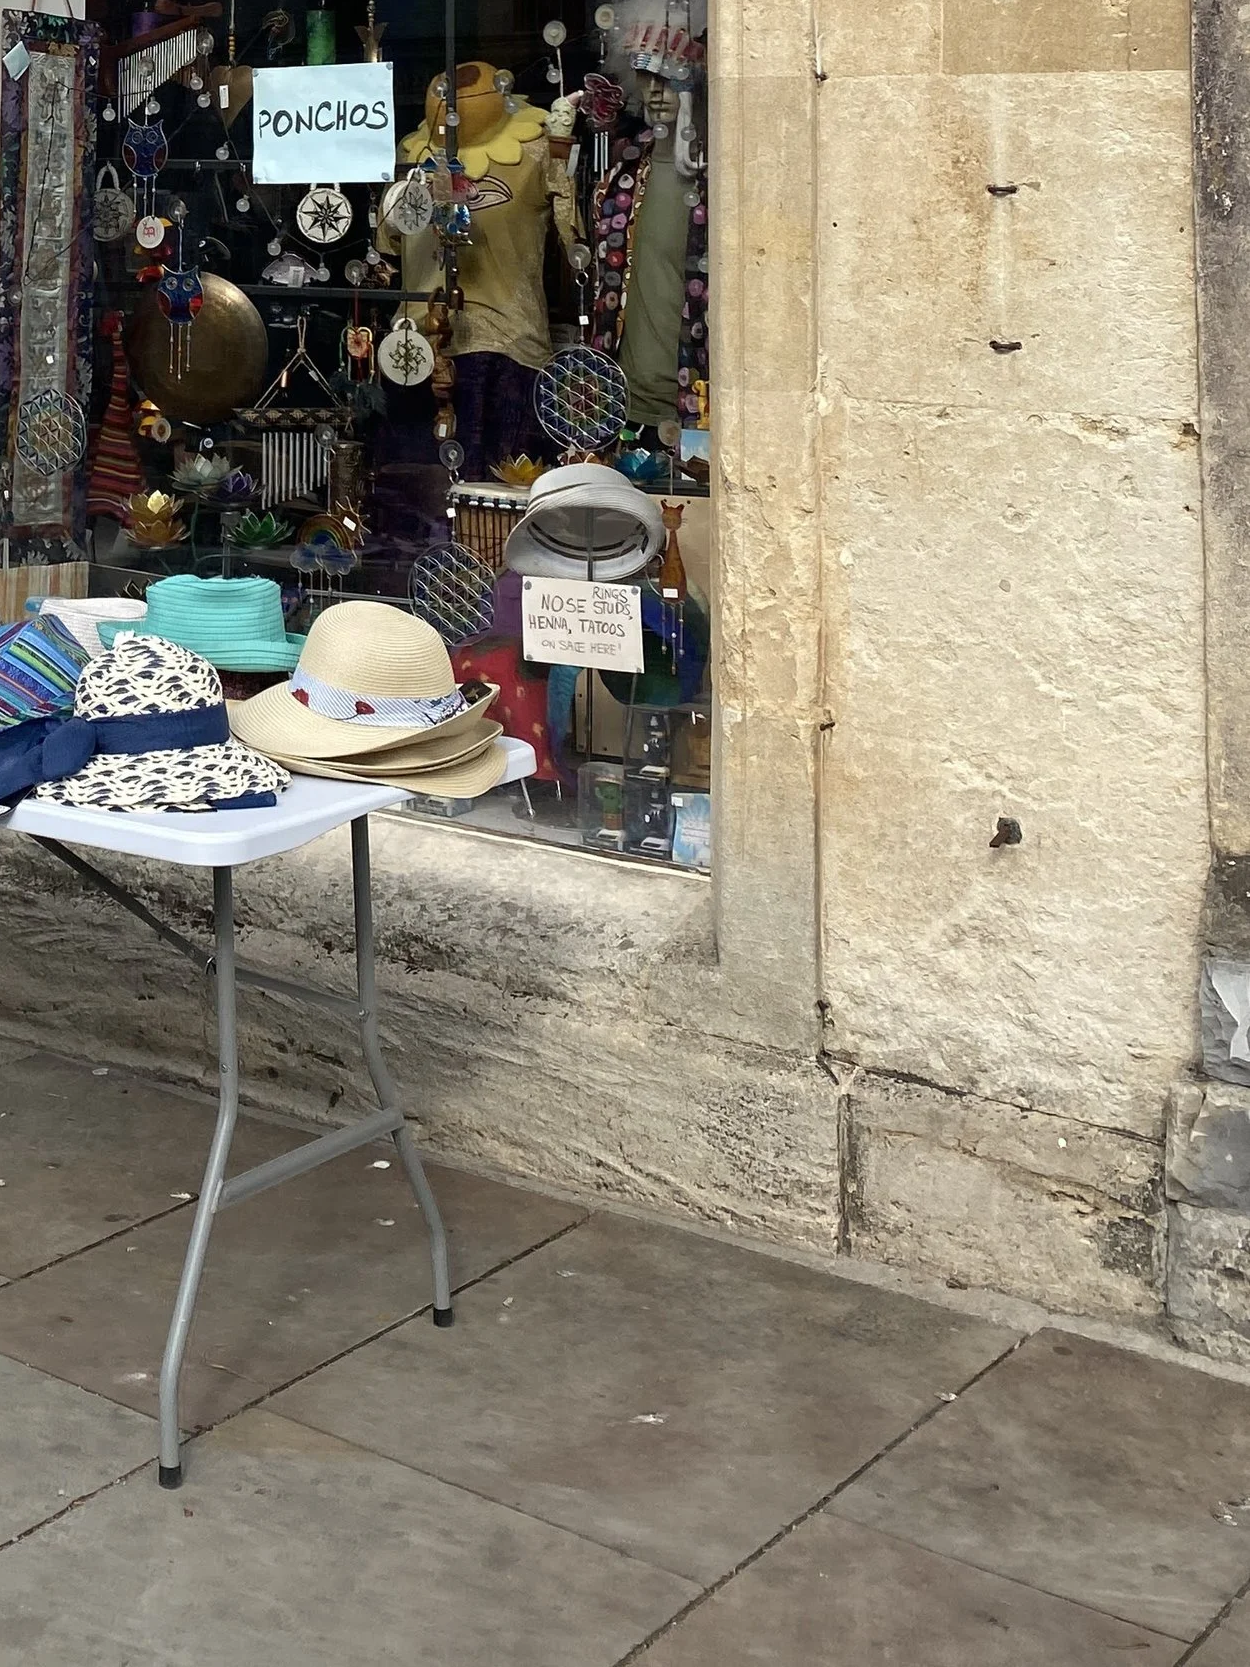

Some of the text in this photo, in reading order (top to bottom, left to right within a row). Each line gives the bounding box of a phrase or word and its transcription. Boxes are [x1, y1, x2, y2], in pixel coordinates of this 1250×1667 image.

[259, 100, 388, 138] PONCHOS
[541, 594, 587, 613] NOSE
[593, 586, 628, 604] RINGS
[529, 614, 626, 637] HENNA, TATOOS
[541, 639, 555, 649] ON
[559, 640, 586, 653] SALE
